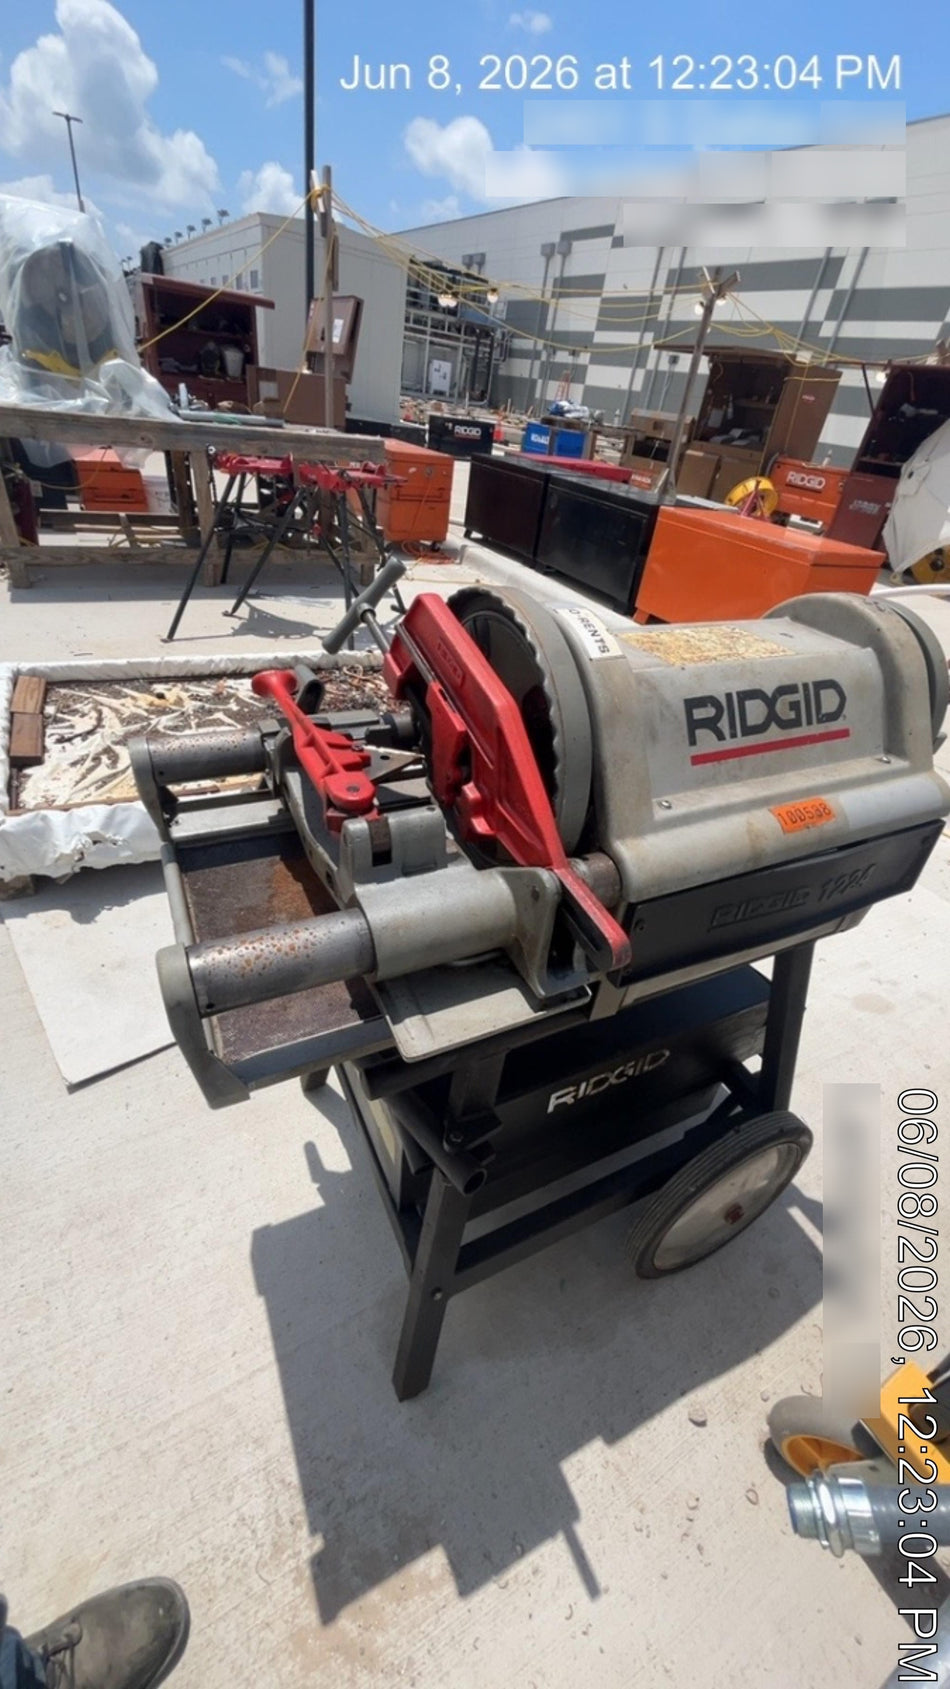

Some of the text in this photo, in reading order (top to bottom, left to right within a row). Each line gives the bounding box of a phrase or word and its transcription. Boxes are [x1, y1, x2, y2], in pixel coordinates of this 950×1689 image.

[785, 470, 827, 490] RIDGID
[683, 678, 848, 748] RIDGID
[546, 1048, 671, 1115] RIDGID
